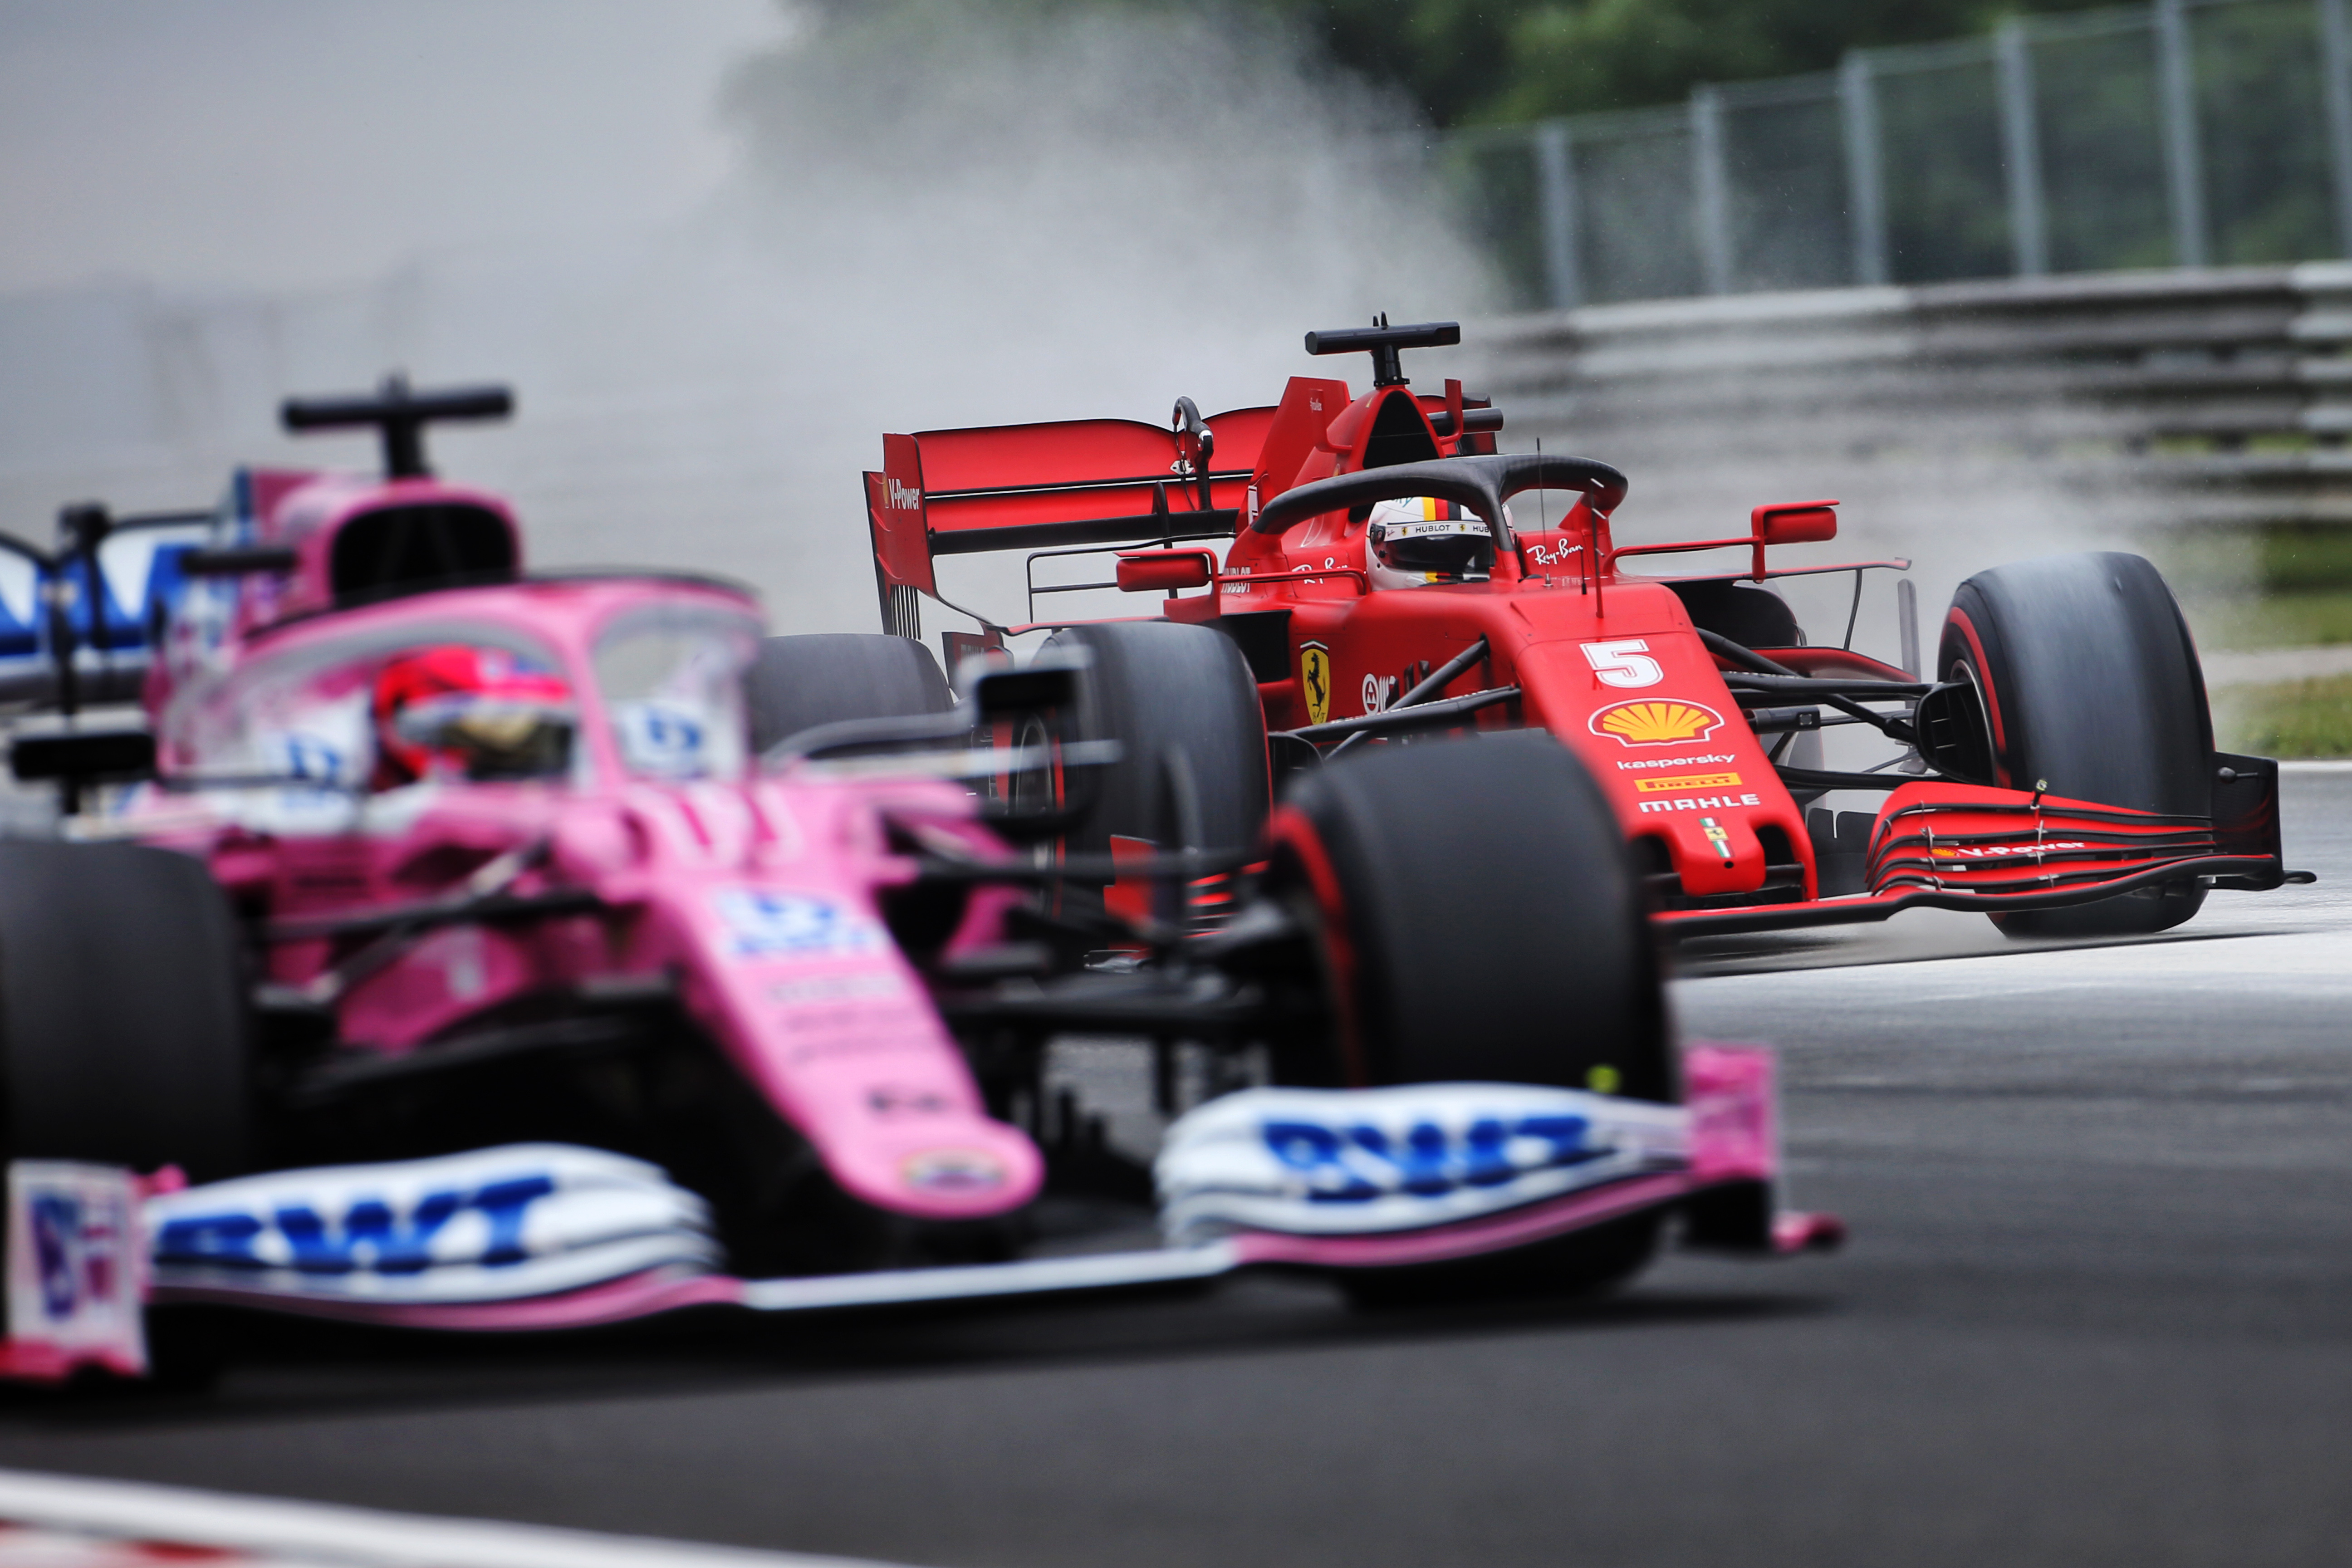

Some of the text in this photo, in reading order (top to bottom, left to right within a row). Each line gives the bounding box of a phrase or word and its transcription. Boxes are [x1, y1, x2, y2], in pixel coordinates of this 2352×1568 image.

[888, 478, 920, 510] V-Power
[1416, 524, 1450, 533] HUBLOT
[1578, 638, 1664, 688] 5
[1617, 754, 1736, 770] kaspersky
[1645, 776, 1730, 789] PIRELLI
[1638, 793, 1761, 813] MAHLE
[1958, 842, 2085, 857] V-Power
